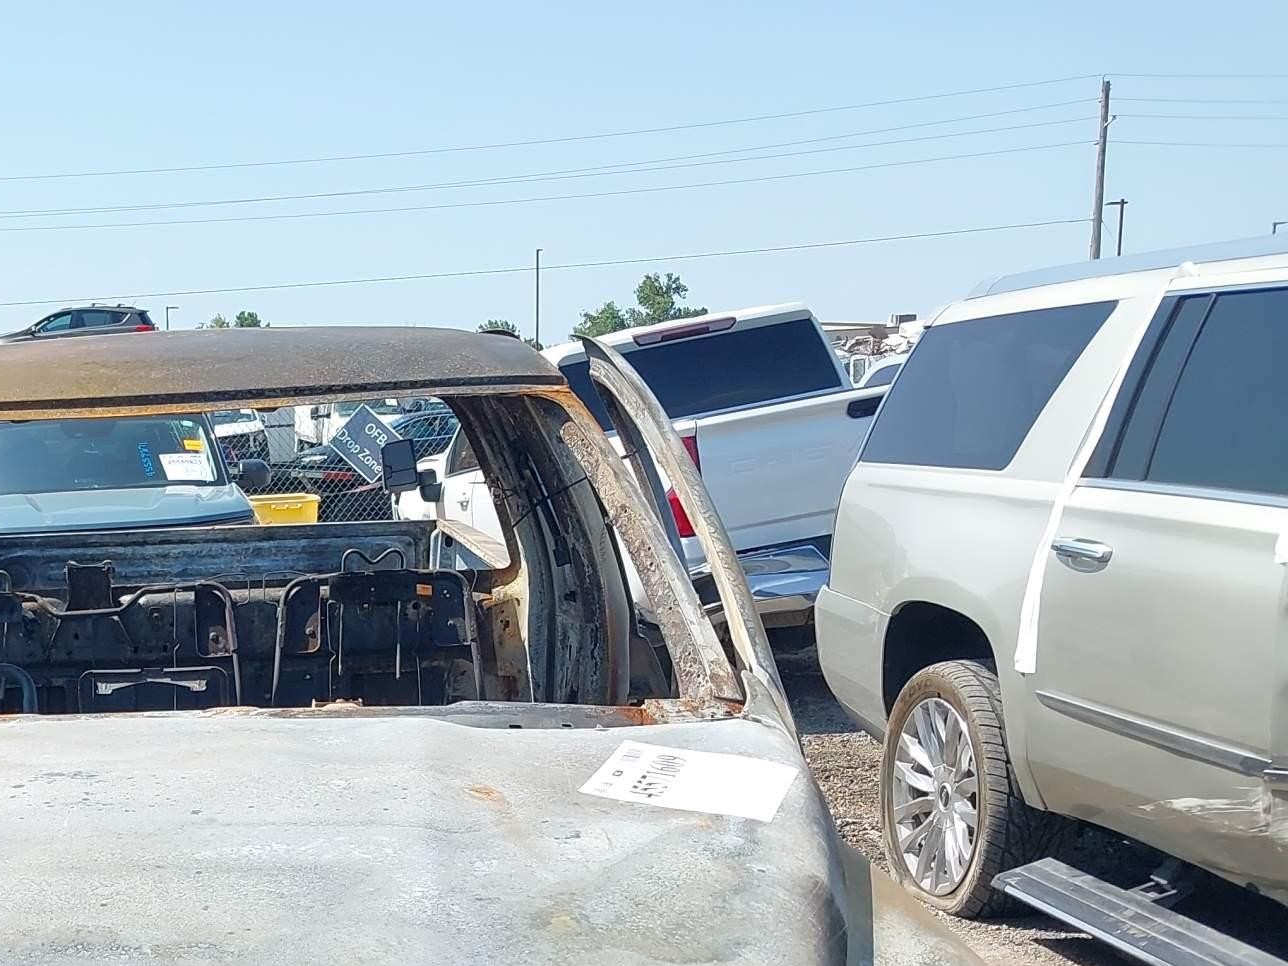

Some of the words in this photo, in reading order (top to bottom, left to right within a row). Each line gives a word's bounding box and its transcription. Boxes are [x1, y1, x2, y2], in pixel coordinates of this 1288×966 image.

[336, 428, 360, 454] Drop
[358, 447, 383, 474] Zone
[365, 423, 387, 445] OFB
